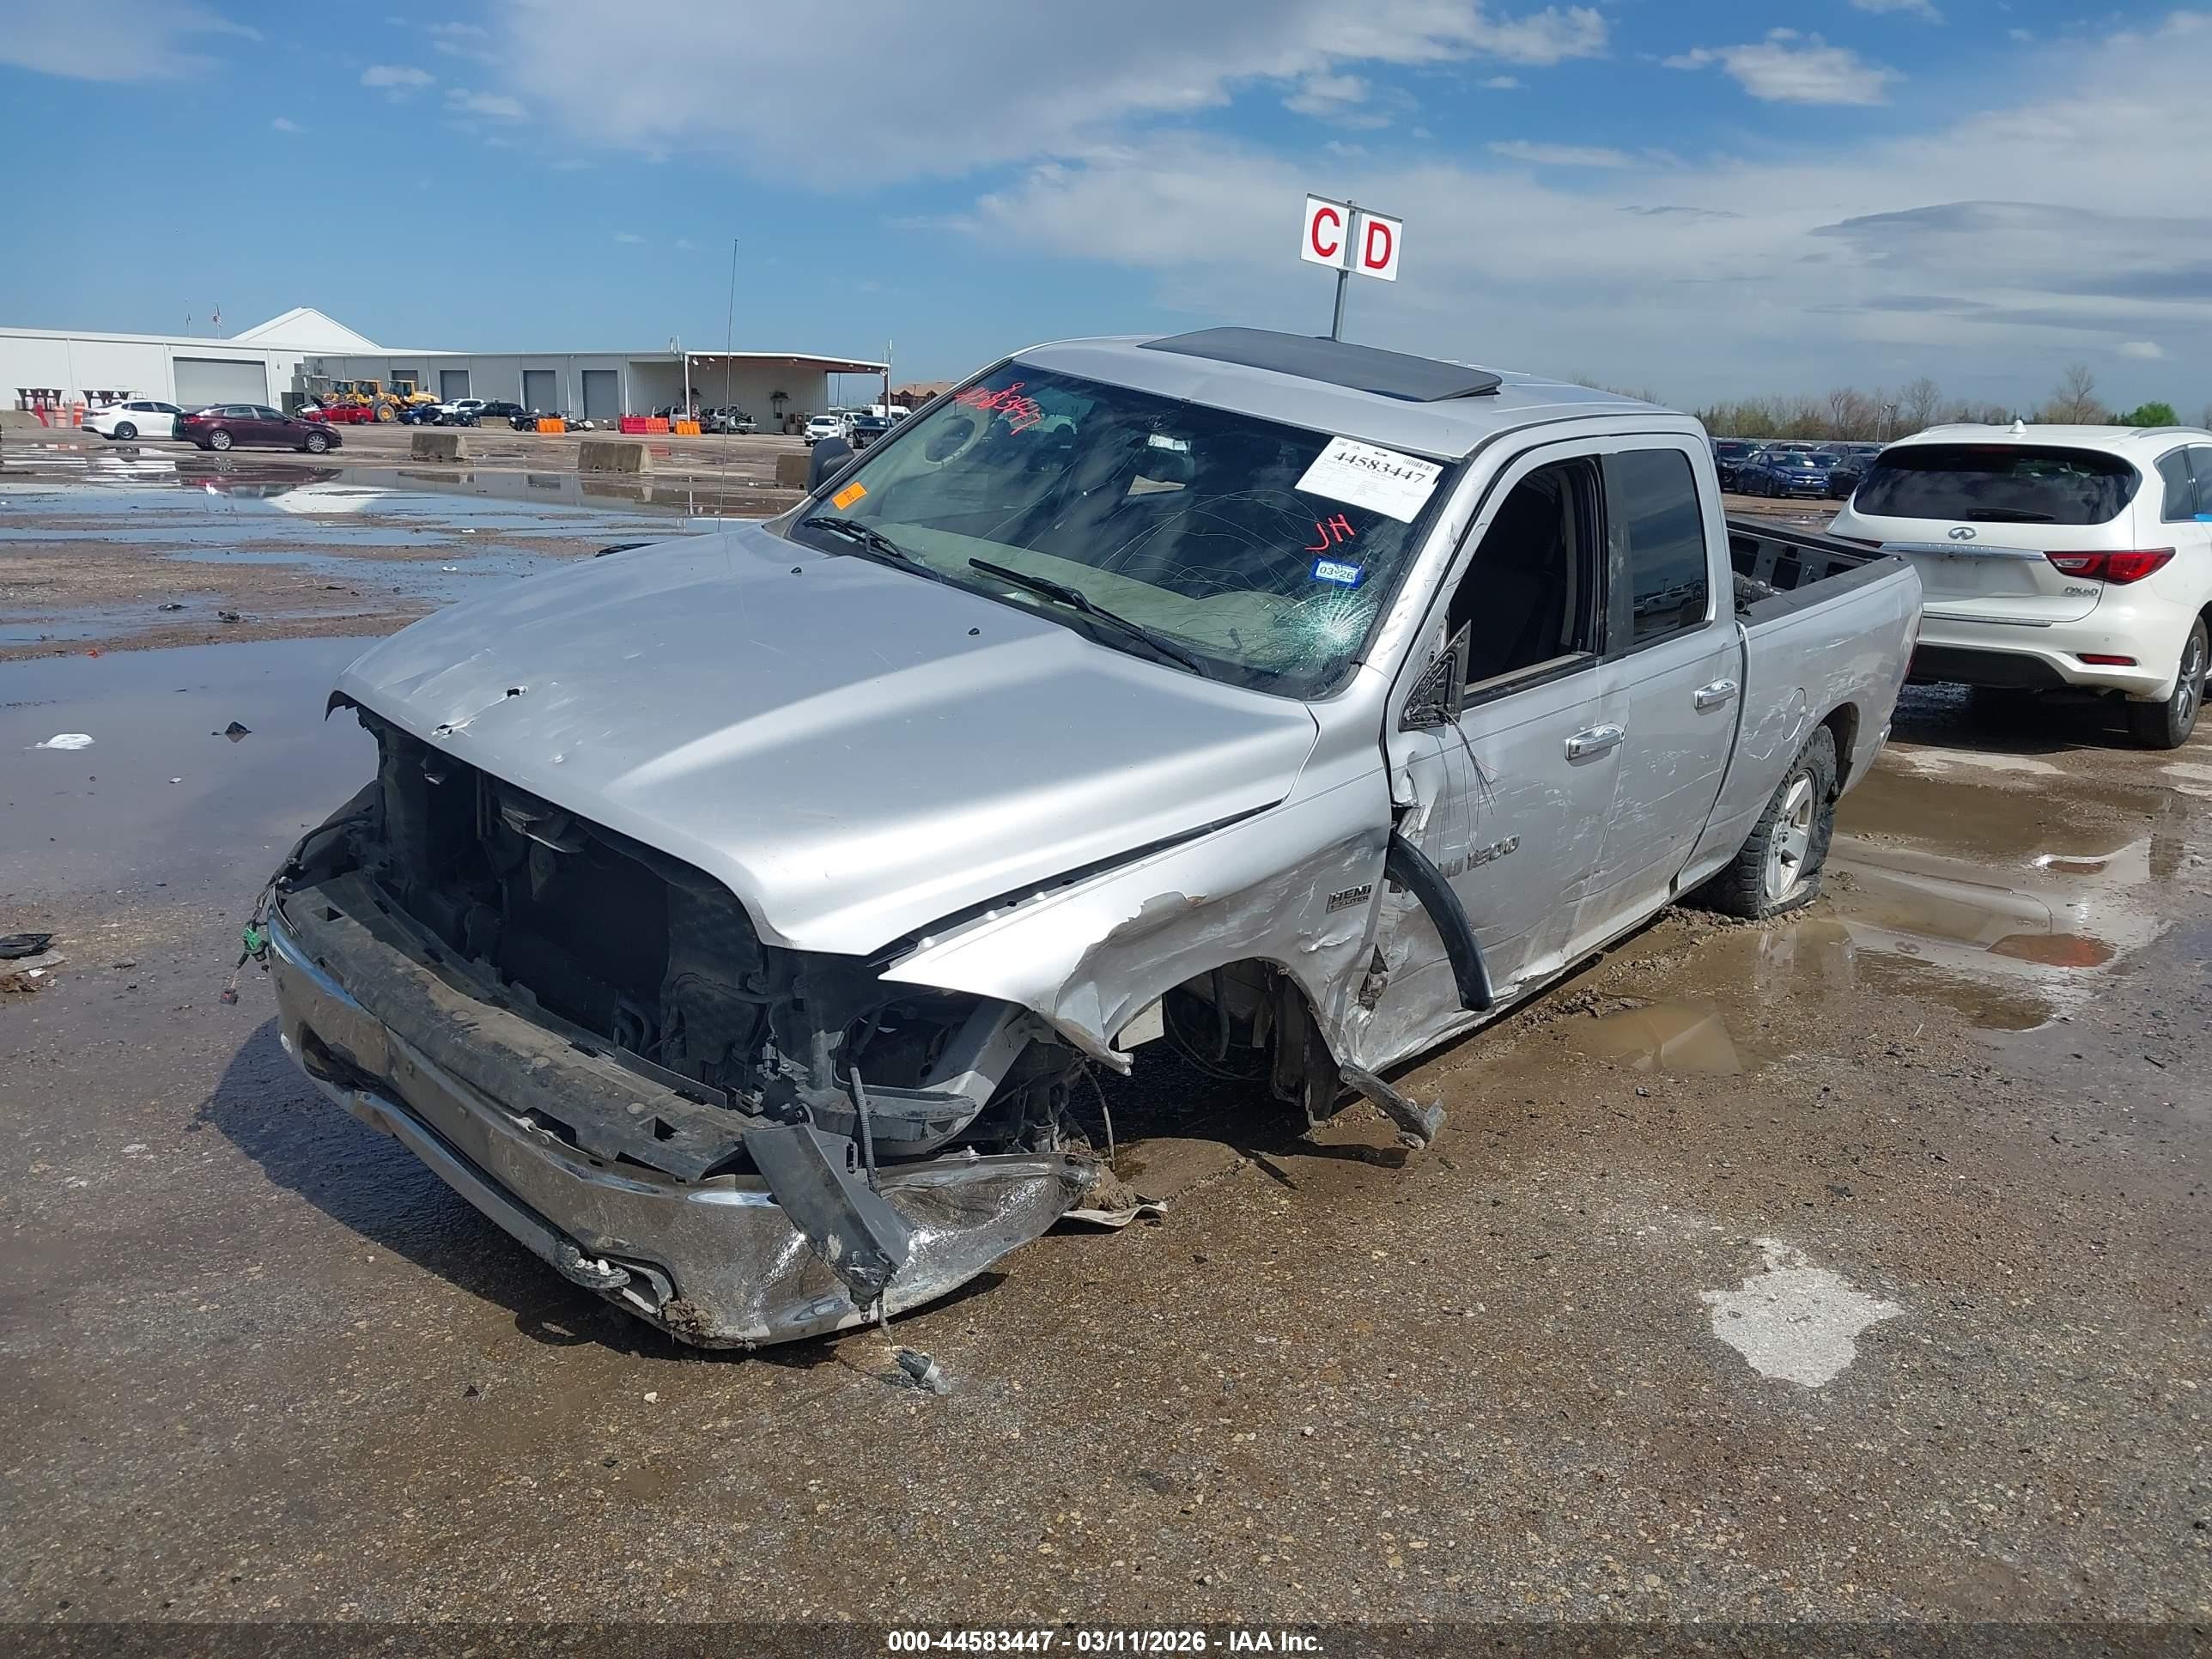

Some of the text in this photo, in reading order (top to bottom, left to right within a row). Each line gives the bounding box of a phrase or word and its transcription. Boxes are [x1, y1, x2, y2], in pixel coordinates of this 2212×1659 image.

[1311, 207, 1340, 258] C
[1364, 220, 1392, 270] D
[1334, 452, 1426, 483] 44583447
[1304, 514, 1356, 550] JH
[1331, 884, 1372, 903] HEMI
[1346, 895, 1369, 905] LITER
